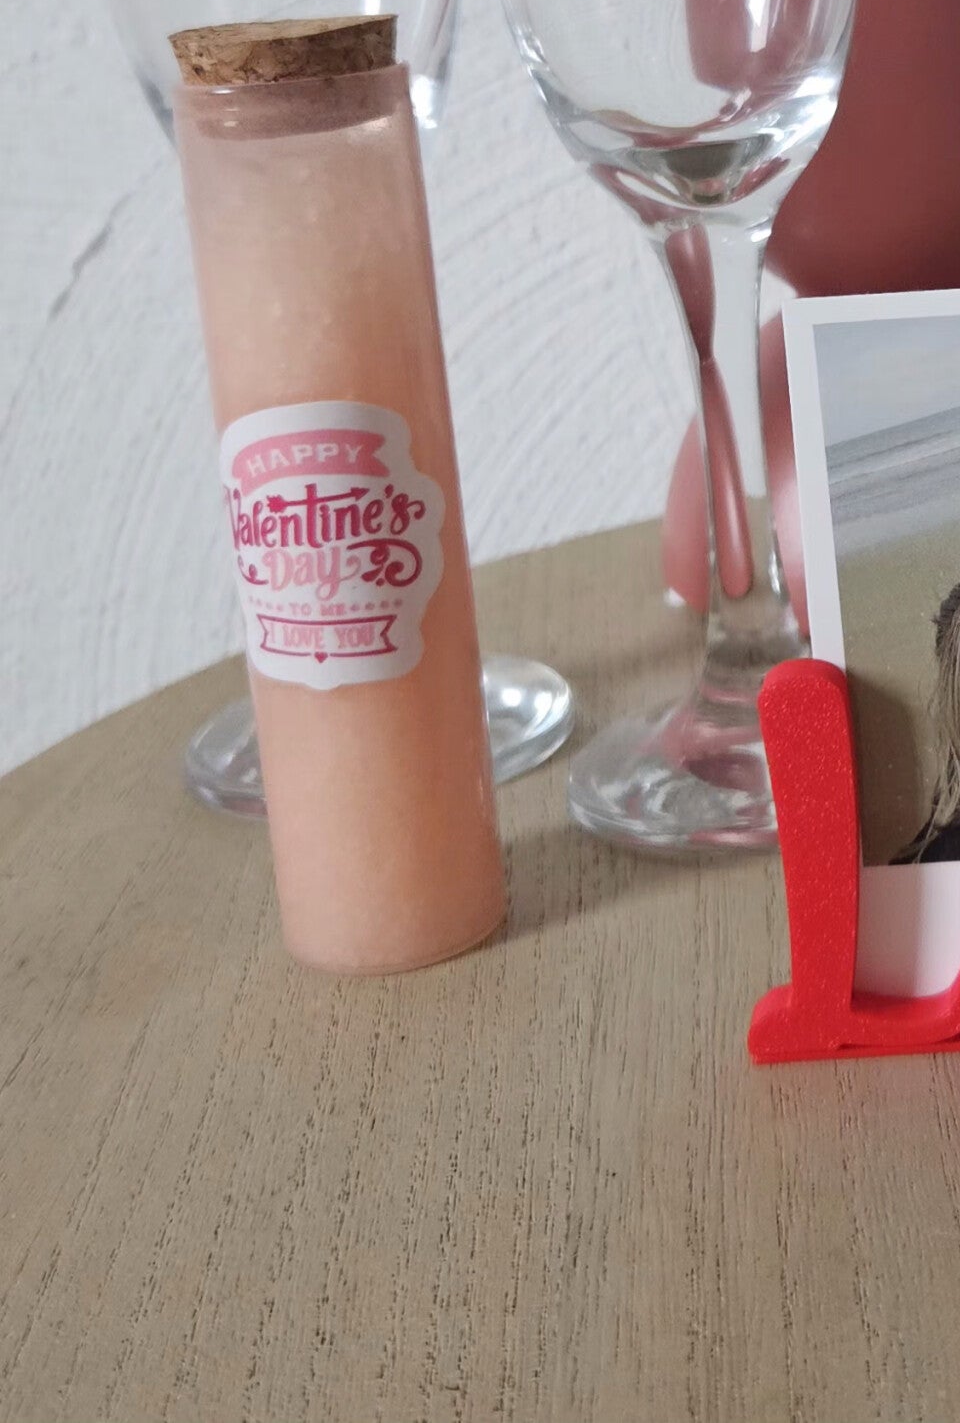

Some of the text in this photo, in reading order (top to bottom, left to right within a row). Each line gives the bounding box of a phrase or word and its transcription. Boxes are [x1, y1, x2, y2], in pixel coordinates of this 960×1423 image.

[247, 442, 364, 478] HAPPY
[224, 483, 426, 551] Valentine's
[261, 546, 361, 602] Day
